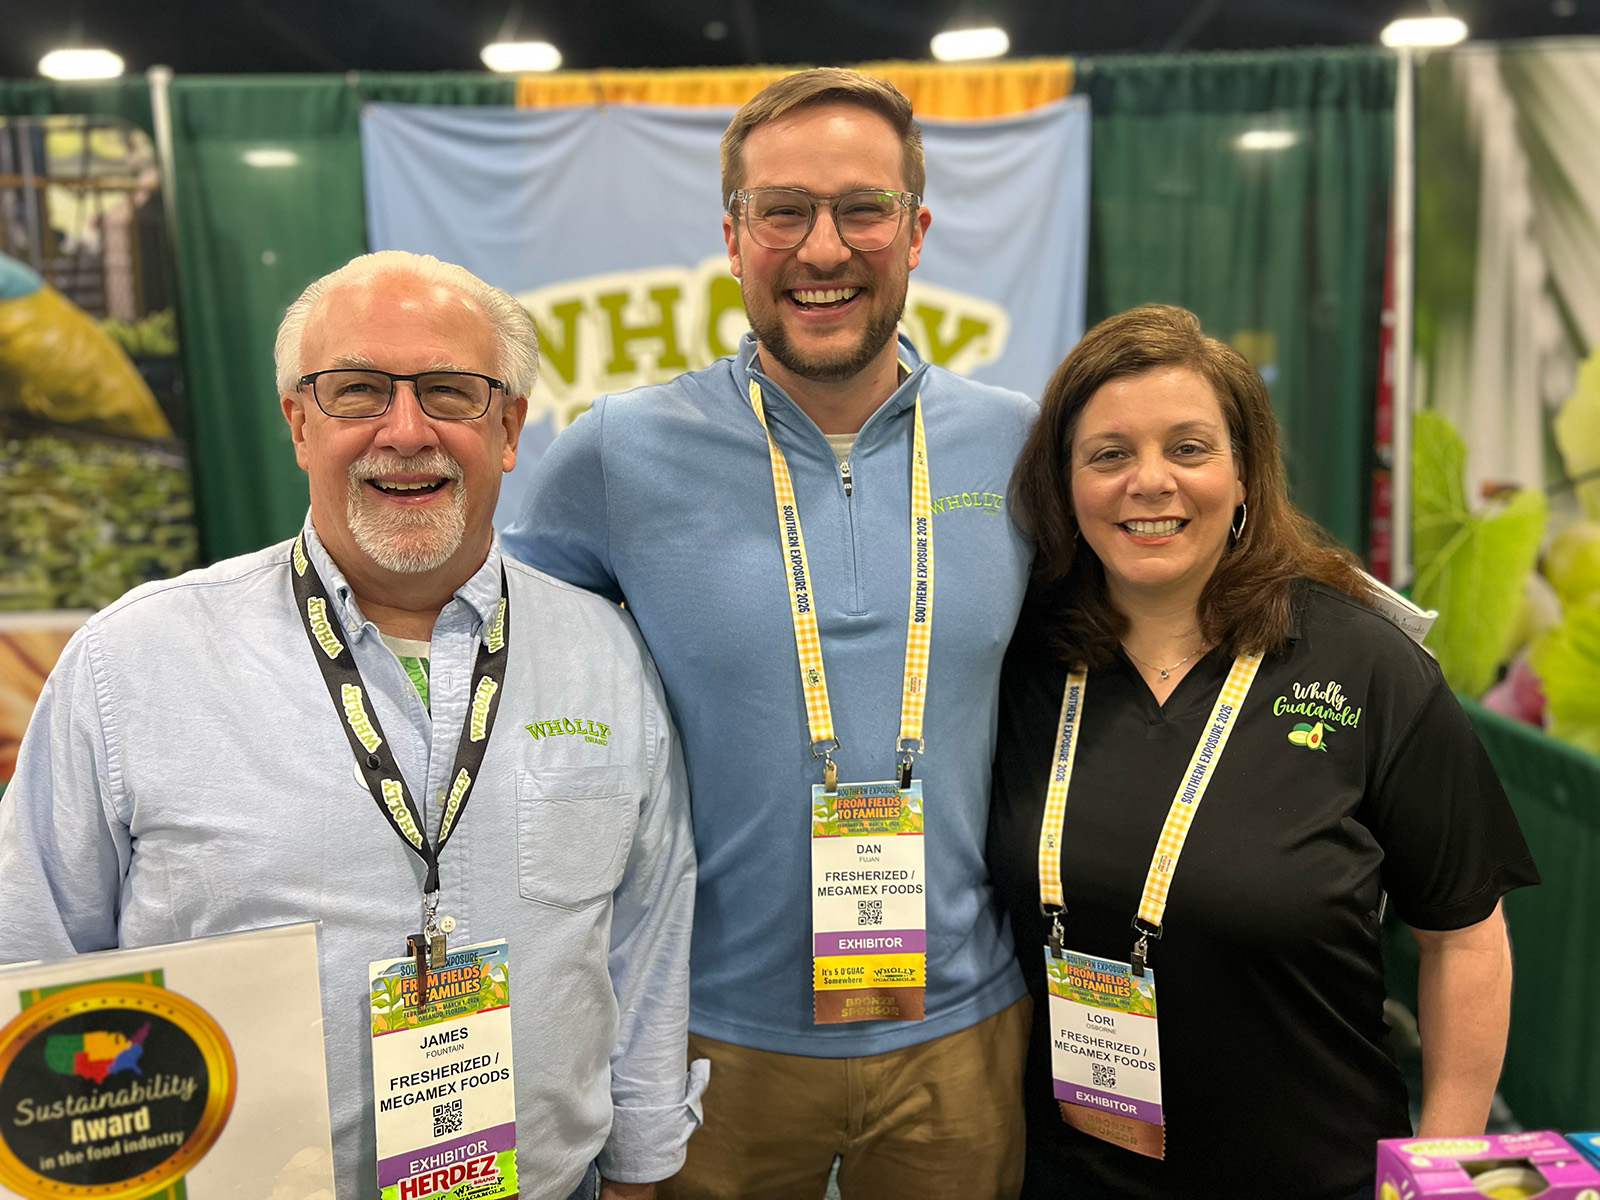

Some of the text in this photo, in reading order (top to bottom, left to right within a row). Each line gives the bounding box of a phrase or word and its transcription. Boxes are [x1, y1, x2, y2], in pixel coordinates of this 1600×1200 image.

[930, 492, 1003, 515] WHOLLY
[783, 505, 811, 613] SOUTHERN EXPOSURE 2026
[914, 517, 928, 623] SOUTHERN EXPOSURE 2026
[309, 599, 340, 657] WHOLLY
[1292, 680, 1348, 711] Wholly
[343, 685, 380, 751] WHOLLY
[473, 678, 496, 740] WHOLLY
[1273, 695, 1362, 729] Guacamole!
[525, 717, 610, 740] WHOLLY
[1055, 686, 1080, 782] SOUTHERN EXPOSURE 2026
[1181, 704, 1233, 804] SOUTHERN EXPOSURE 2026
[837, 787, 868, 797] SOUTHERN
[837, 796, 901, 809] FROM FIELDS
[383, 780, 421, 847] WHOLLY
[438, 770, 469, 841] WHOLLY
[837, 806, 901, 820] TO FAMILIES
[856, 844, 882, 854] DAN
[825, 870, 908, 882] FRESHERIZED
[817, 883, 924, 897] MEGAMEX FOODS
[838, 937, 903, 950] EXHIBITOR
[445, 952, 479, 967] XPOSURE
[1097, 962, 1128, 974] EXPOSURE
[402, 973, 438, 992] FRM
[440, 965, 480, 985] FIELDS
[821, 968, 832, 976] It's
[823, 977, 863, 985] Somewhere
[873, 967, 916, 976] WHOLLY
[1068, 965, 1130, 987] FROM FIELDS
[1068, 975, 1082, 987] TO
[1082, 979, 1131, 997] FAMILIES
[403, 992, 419, 1007] TO
[841, 1005, 900, 1017] SPONSOR
[845, 996, 895, 1007] BRONZE
[1086, 1023, 1117, 1035] OSBORNE
[1087, 1012, 1114, 1027] LORI
[419, 1026, 469, 1050] JAMES
[1060, 1029, 1140, 1056] FRESHERIZED
[425, 1043, 465, 1059] FOUNTAIN
[1054, 1040, 1156, 1072] MEGAMEX FOODS
[390, 1054, 491, 1091] FRESHERIZED
[13, 1073, 197, 1126] Sustainability
[380, 1068, 510, 1113] MEGAMEX FOODS
[1075, 1090, 1138, 1115] EXHIBITOR
[70, 1106, 151, 1145] Award
[39, 1131, 185, 1171] in the food industry
[409, 1140, 488, 1174] EXHIBITOR
[473, 1176, 496, 1185] BRAND
